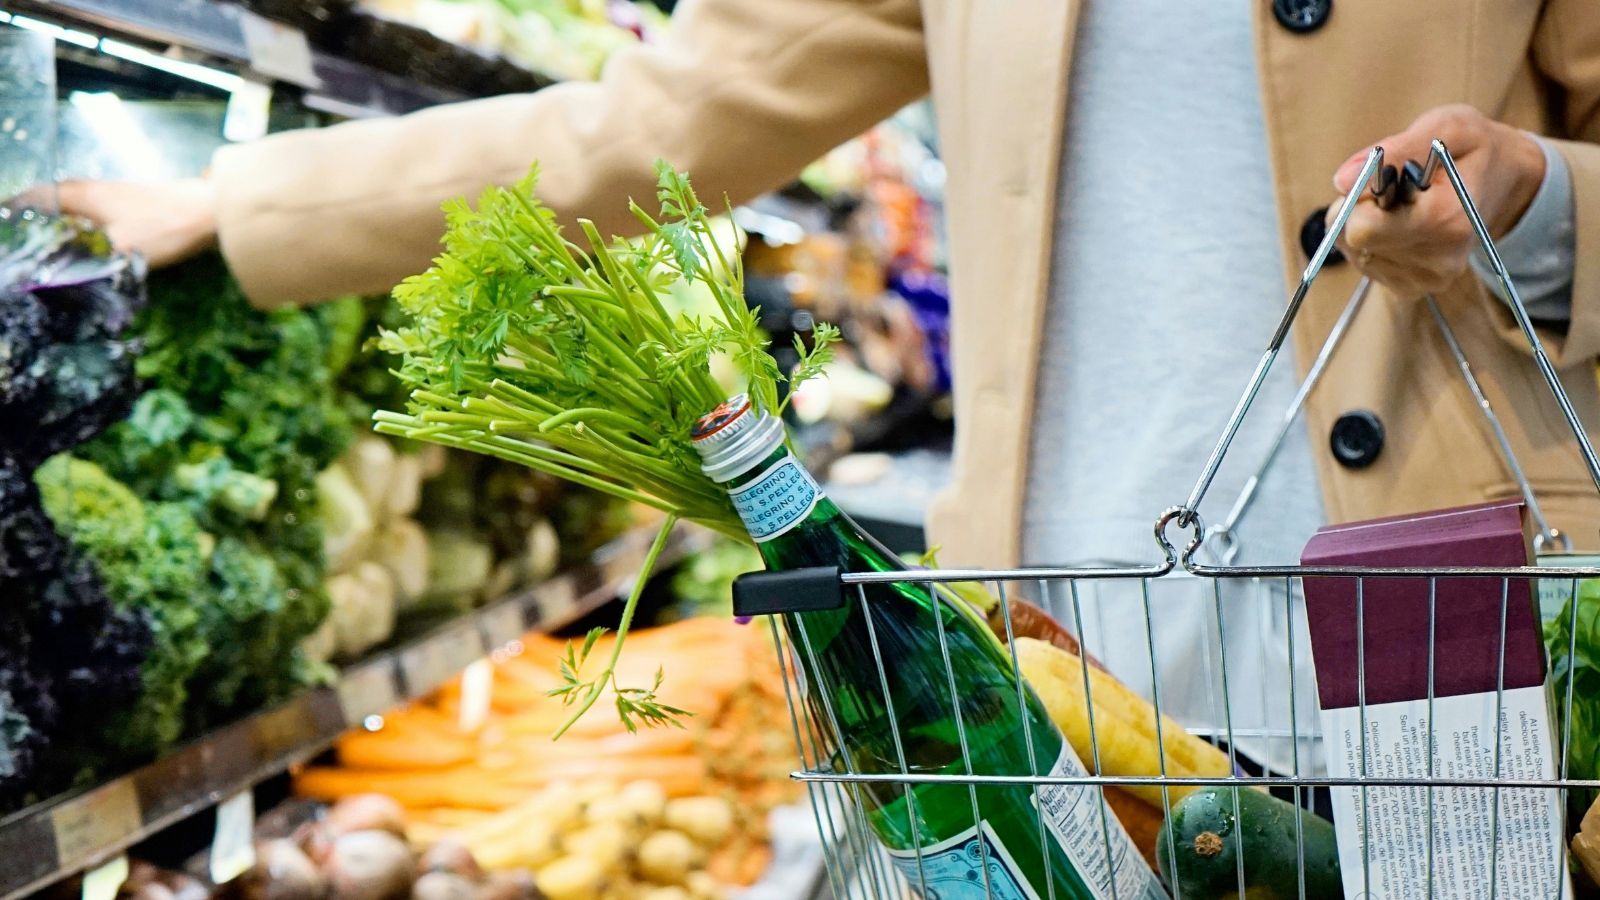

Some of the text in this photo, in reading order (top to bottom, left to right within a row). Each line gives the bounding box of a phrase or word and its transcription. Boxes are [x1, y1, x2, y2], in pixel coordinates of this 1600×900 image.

[1399, 714, 1408, 732] Seul
[1518, 710, 1530, 745] delicious
[1529, 718, 1537, 726] At
[1402, 734, 1409, 744] un
[1410, 726, 1418, 745] avec
[1452, 731, 1462, 760] cheese
[1462, 731, 1470, 743] but
[1470, 725, 1479, 748] these
[1529, 728, 1541, 755] Lesley
[1462, 746, 1472, 767] really
[1504, 743, 1512, 756] her
[1403, 747, 1414, 774] produit
[1457, 762, 1463, 770] or
[1473, 750, 1483, 776] unique
[1506, 759, 1515, 779] team
[1347, 750, 1353, 760] ne
[1352, 794, 1361, 810] plus
[1384, 754, 1397, 798] CRAEZ
[1371, 793, 1378, 803] de
[1470, 792, 1478, 813] when
[1501, 792, 1511, 821] scratch
[1520, 794, 1529, 810] with
[1376, 759, 1382, 769] au
[1383, 819, 1395, 859] craquelins
[1391, 799, 1400, 825] POUR
[1440, 804, 1449, 828] Foods
[1464, 812, 1471, 826] We
[1512, 803, 1520, 815] the
[1530, 796, 1541, 829] fabulous
[1540, 804, 1550, 829] Foods
[1472, 816, 1482, 843] topped
[1513, 818, 1522, 834] only
[1522, 812, 1530, 830] care
[1394, 827, 1403, 845] CES
[1404, 816, 1415, 851] satisfaire
[1443, 831, 1452, 853] adore
[1504, 823, 1514, 845] using
[1515, 836, 1523, 851] way
[1533, 831, 1544, 855] crisps
[1544, 831, 1551, 843] we
[1379, 847, 1385, 857] de
[1397, 848, 1406, 868] FINS
[1467, 843, 1478, 876] addicted
[1477, 845, 1485, 860] with
[1518, 854, 1526, 862] to
[1526, 841, 1535, 863] small
[1546, 845, 1554, 861] love
[1378, 859, 1390, 891] fromage
[1408, 854, 1418, 879] Lesley
[1478, 863, 1487, 880] your
[1510, 862, 1519, 883] finest
[1520, 864, 1529, 885] make
[1537, 857, 1547, 875] from
[1463, 880, 1470, 889] be
